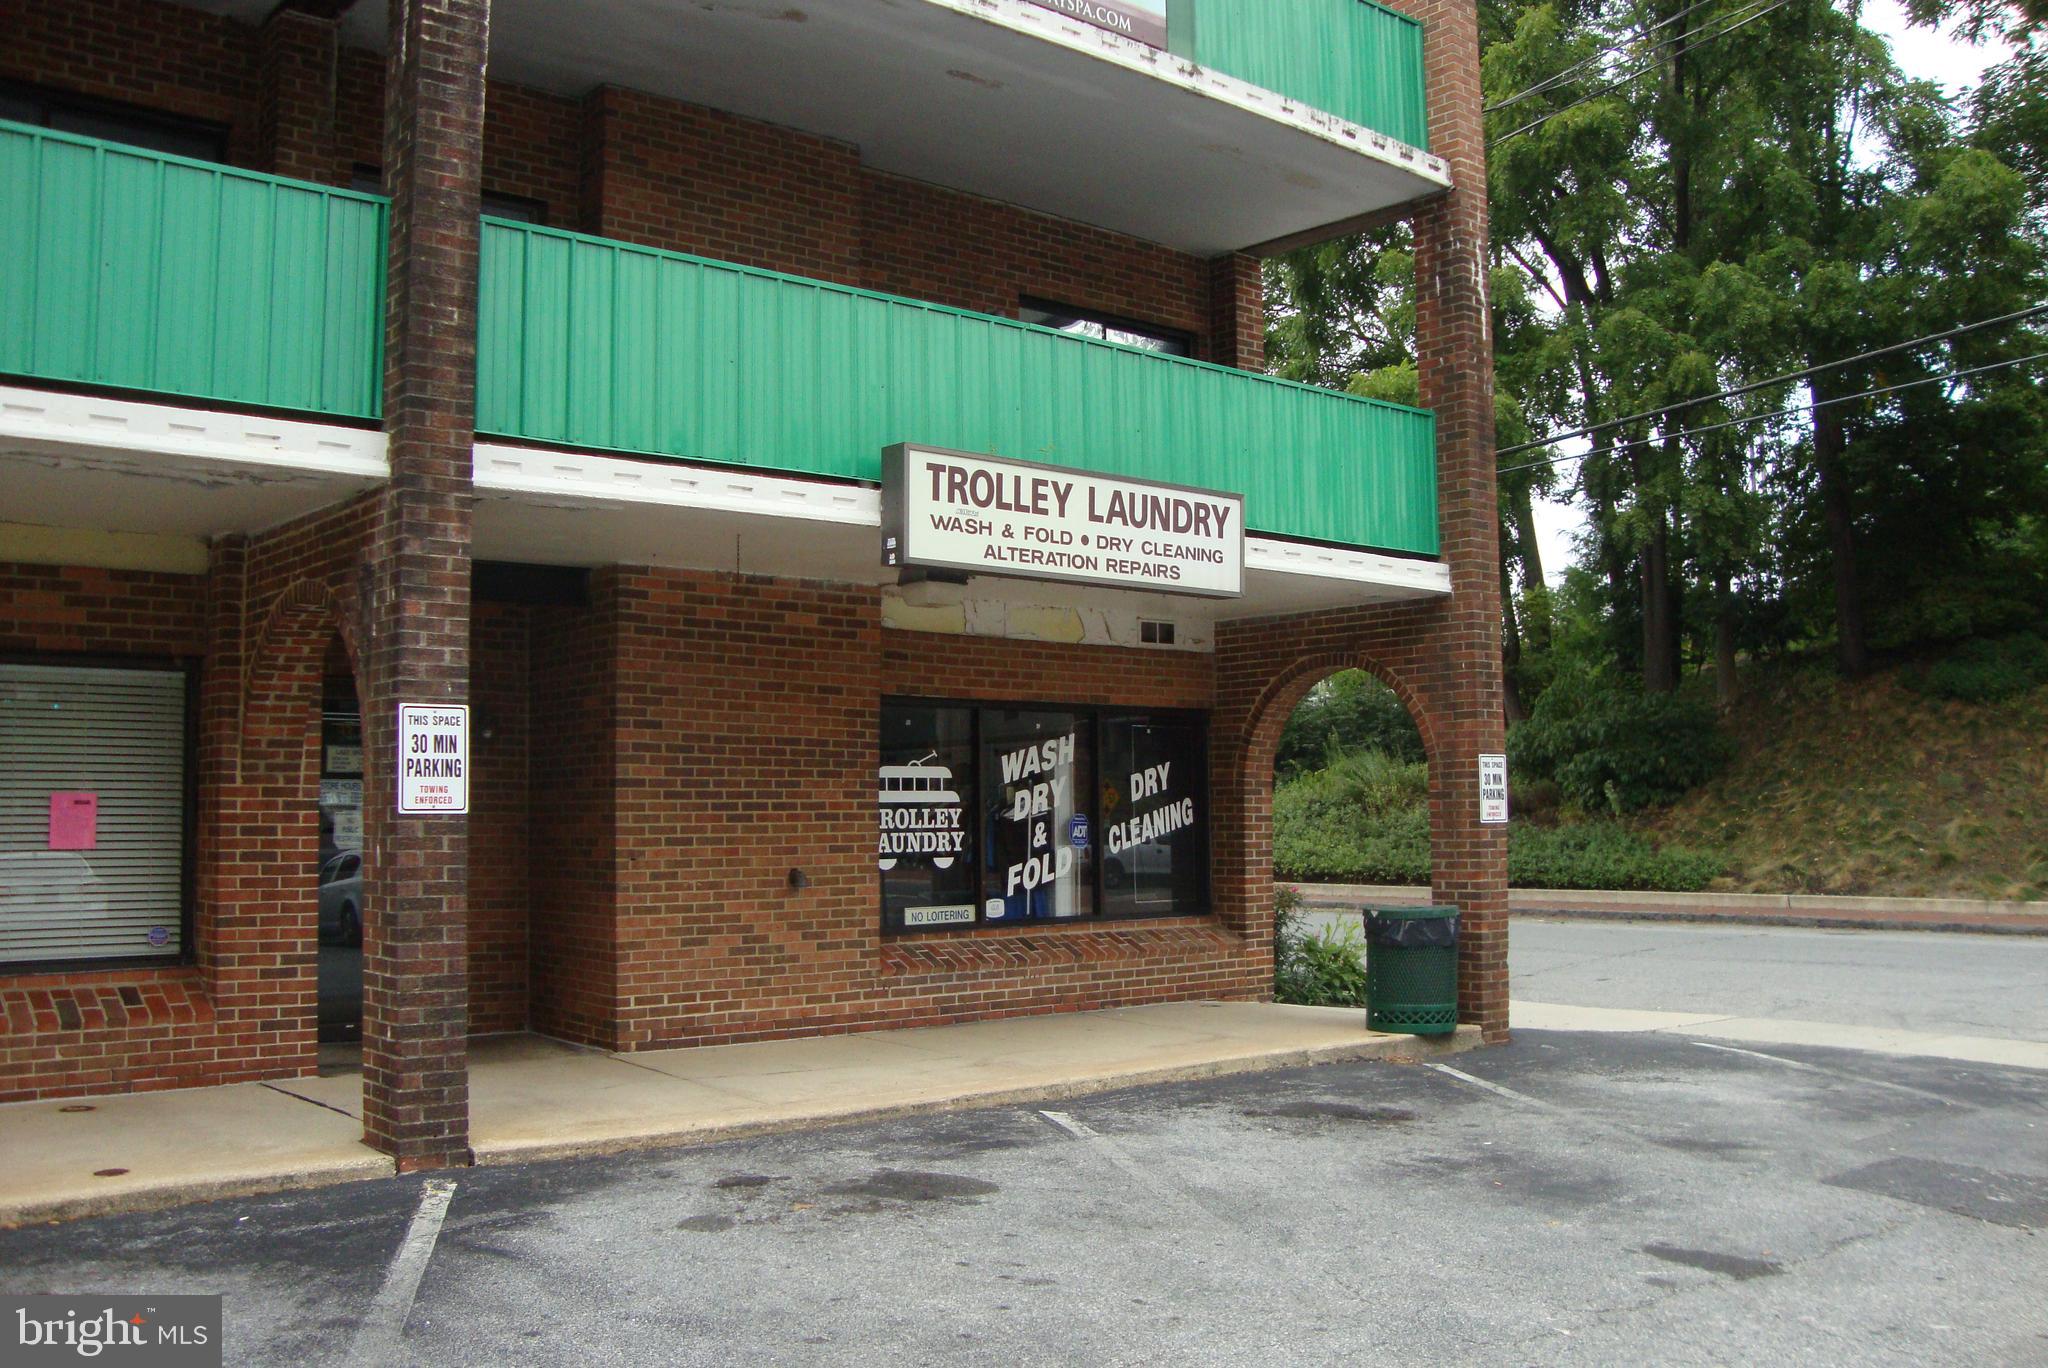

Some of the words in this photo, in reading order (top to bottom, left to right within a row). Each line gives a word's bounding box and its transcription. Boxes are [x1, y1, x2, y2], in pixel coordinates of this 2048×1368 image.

[925, 462, 1073, 518] TROLLEY
[1088, 486, 1231, 539] LAUNDRY
[929, 513, 993, 537] WASH
[1001, 524, 1015, 539] &
[1024, 526, 1073, 546] FOLD
[1096, 535, 1134, 553] DRY
[1141, 540, 1224, 564] CLEANING
[983, 544, 1098, 571] ALTERATION
[1105, 558, 1181, 580] REPAIRS
[408, 715, 429, 726] THIS
[432, 716, 461, 727] SPACE
[411, 733, 428, 754] 30
[433, 734, 457, 754] MIN
[406, 758, 462, 778] PARKING
[1001, 733, 1076, 785] WASH
[420, 785, 449, 794] TOWING
[1130, 761, 1171, 802] DRY
[414, 796, 453, 804] ENFORCED
[1013, 776, 1067, 822] DRY
[879, 808, 962, 829] ROLLEY
[1108, 797, 1194, 854] CLEANING
[878, 831, 965, 853] AUNDRY
[1032, 821, 1048, 848] &
[1072, 825, 1088, 838] ADT
[1006, 847, 1073, 897] FOLD
[911, 912, 924, 922] NO
[926, 909, 970, 922] LOITERING
